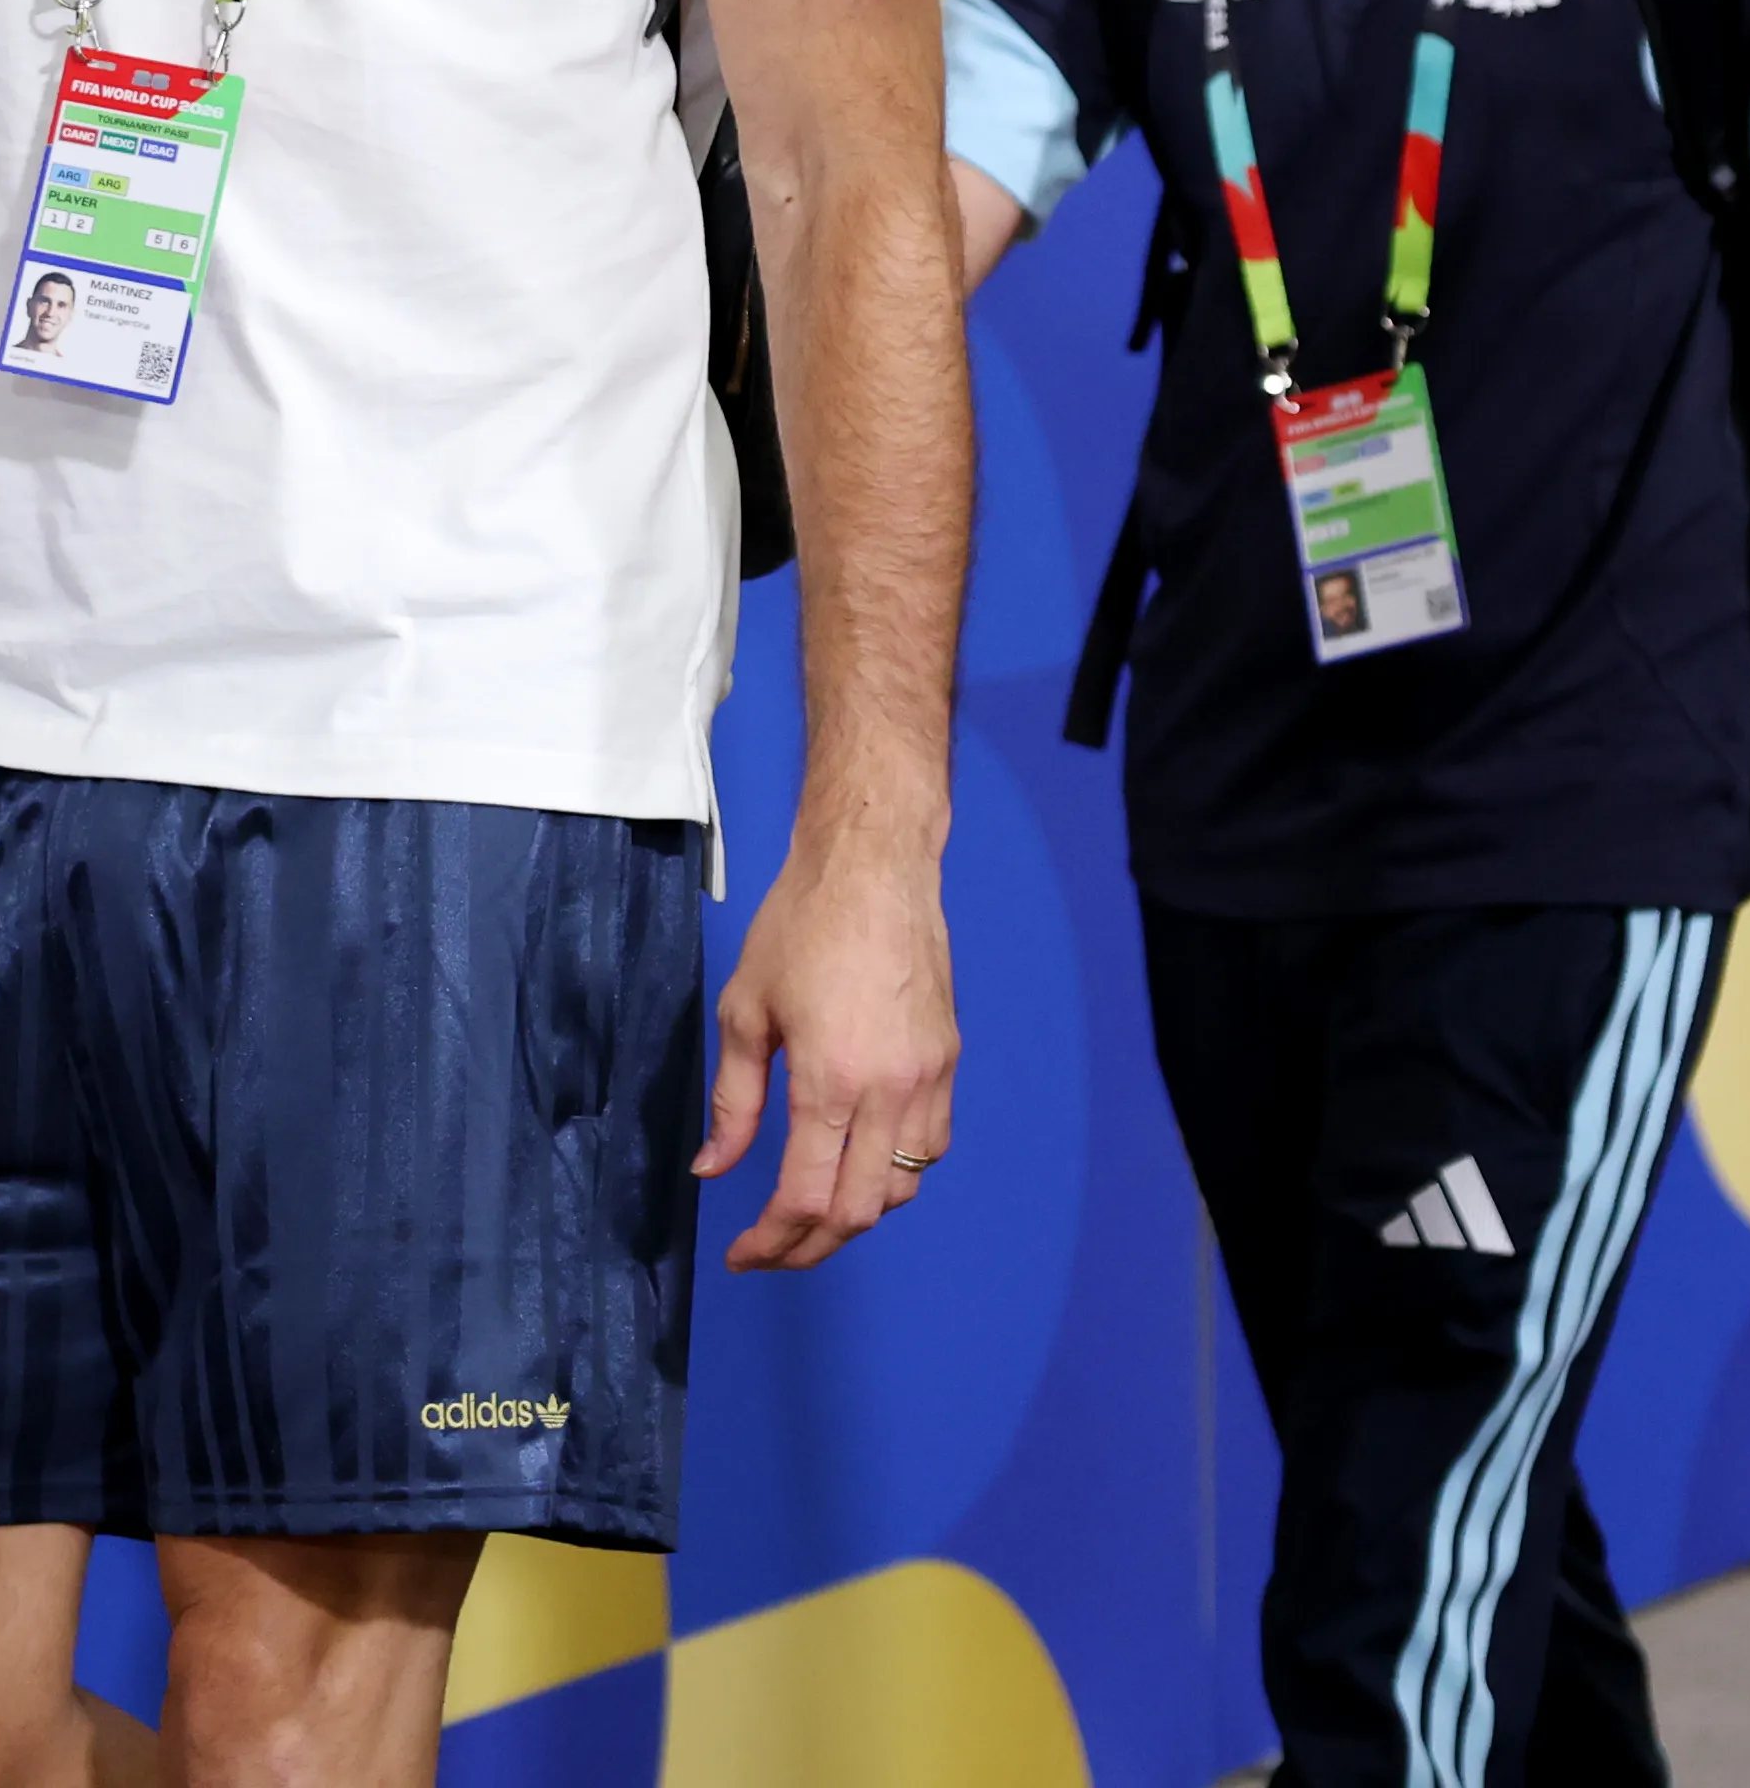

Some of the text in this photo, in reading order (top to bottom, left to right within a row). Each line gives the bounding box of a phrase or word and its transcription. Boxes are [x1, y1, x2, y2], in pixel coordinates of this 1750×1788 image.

[71, 79, 225, 119] FIFA WORLD CUP 2026
[97, 114, 190, 140] TOURNAMENT PASS
[97, 176, 121, 191] ARG
[48, 190, 98, 209] PLAYER
[76, 217, 85, 230] 2
[154, 233, 163, 245] 5
[180, 238, 189, 250] 6
[90, 279, 153, 300] MARTINEZ
[86, 295, 139, 316] Emiliano
[421, 1393, 534, 1429] adidas
